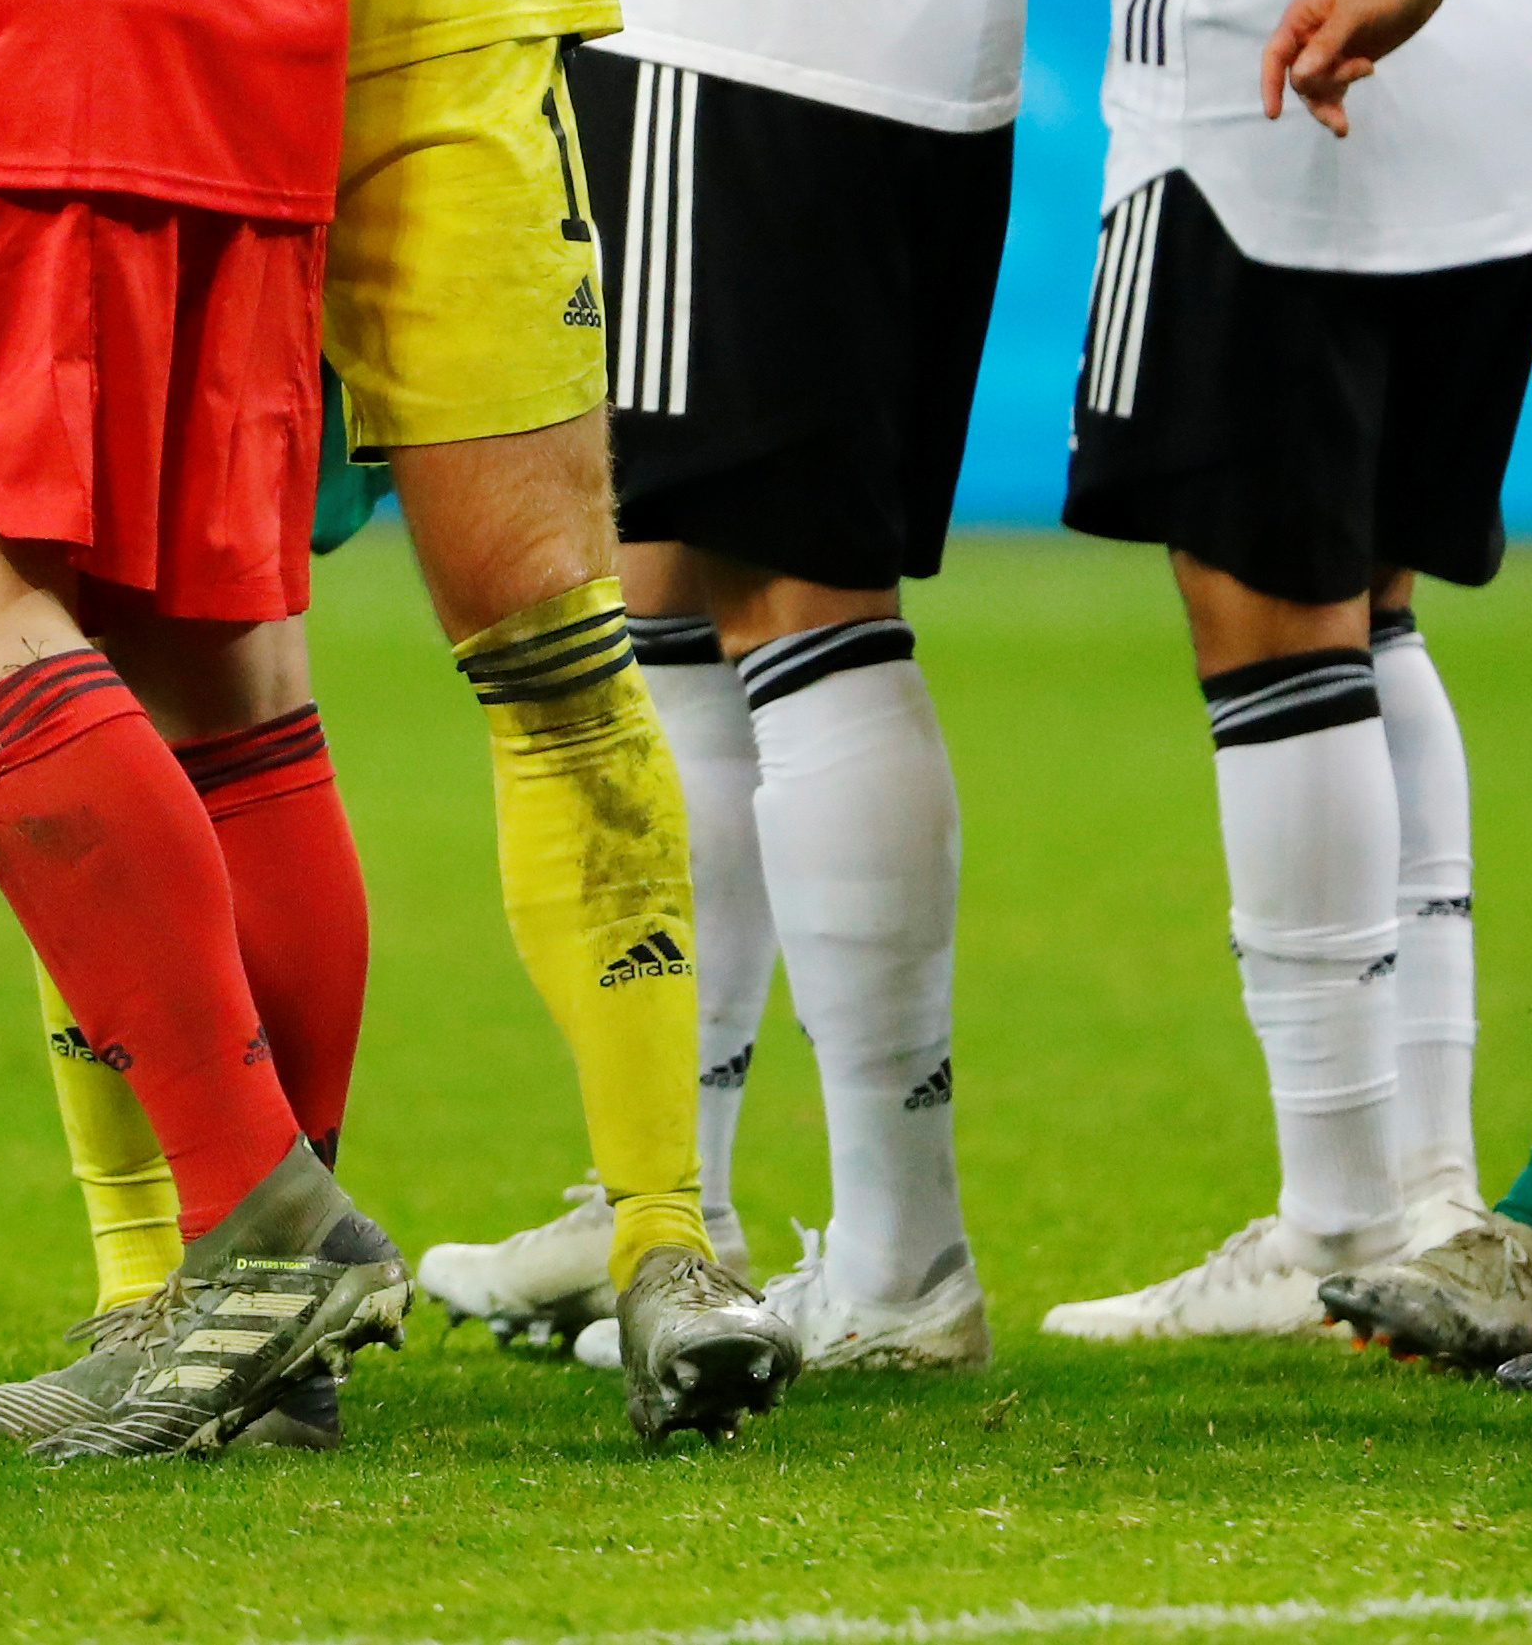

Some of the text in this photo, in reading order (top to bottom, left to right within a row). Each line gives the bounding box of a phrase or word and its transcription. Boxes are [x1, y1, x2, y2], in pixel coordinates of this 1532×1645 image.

[541, 87, 591, 242] 1
[563, 311, 601, 329] adida
[599, 961, 692, 988] adidas
